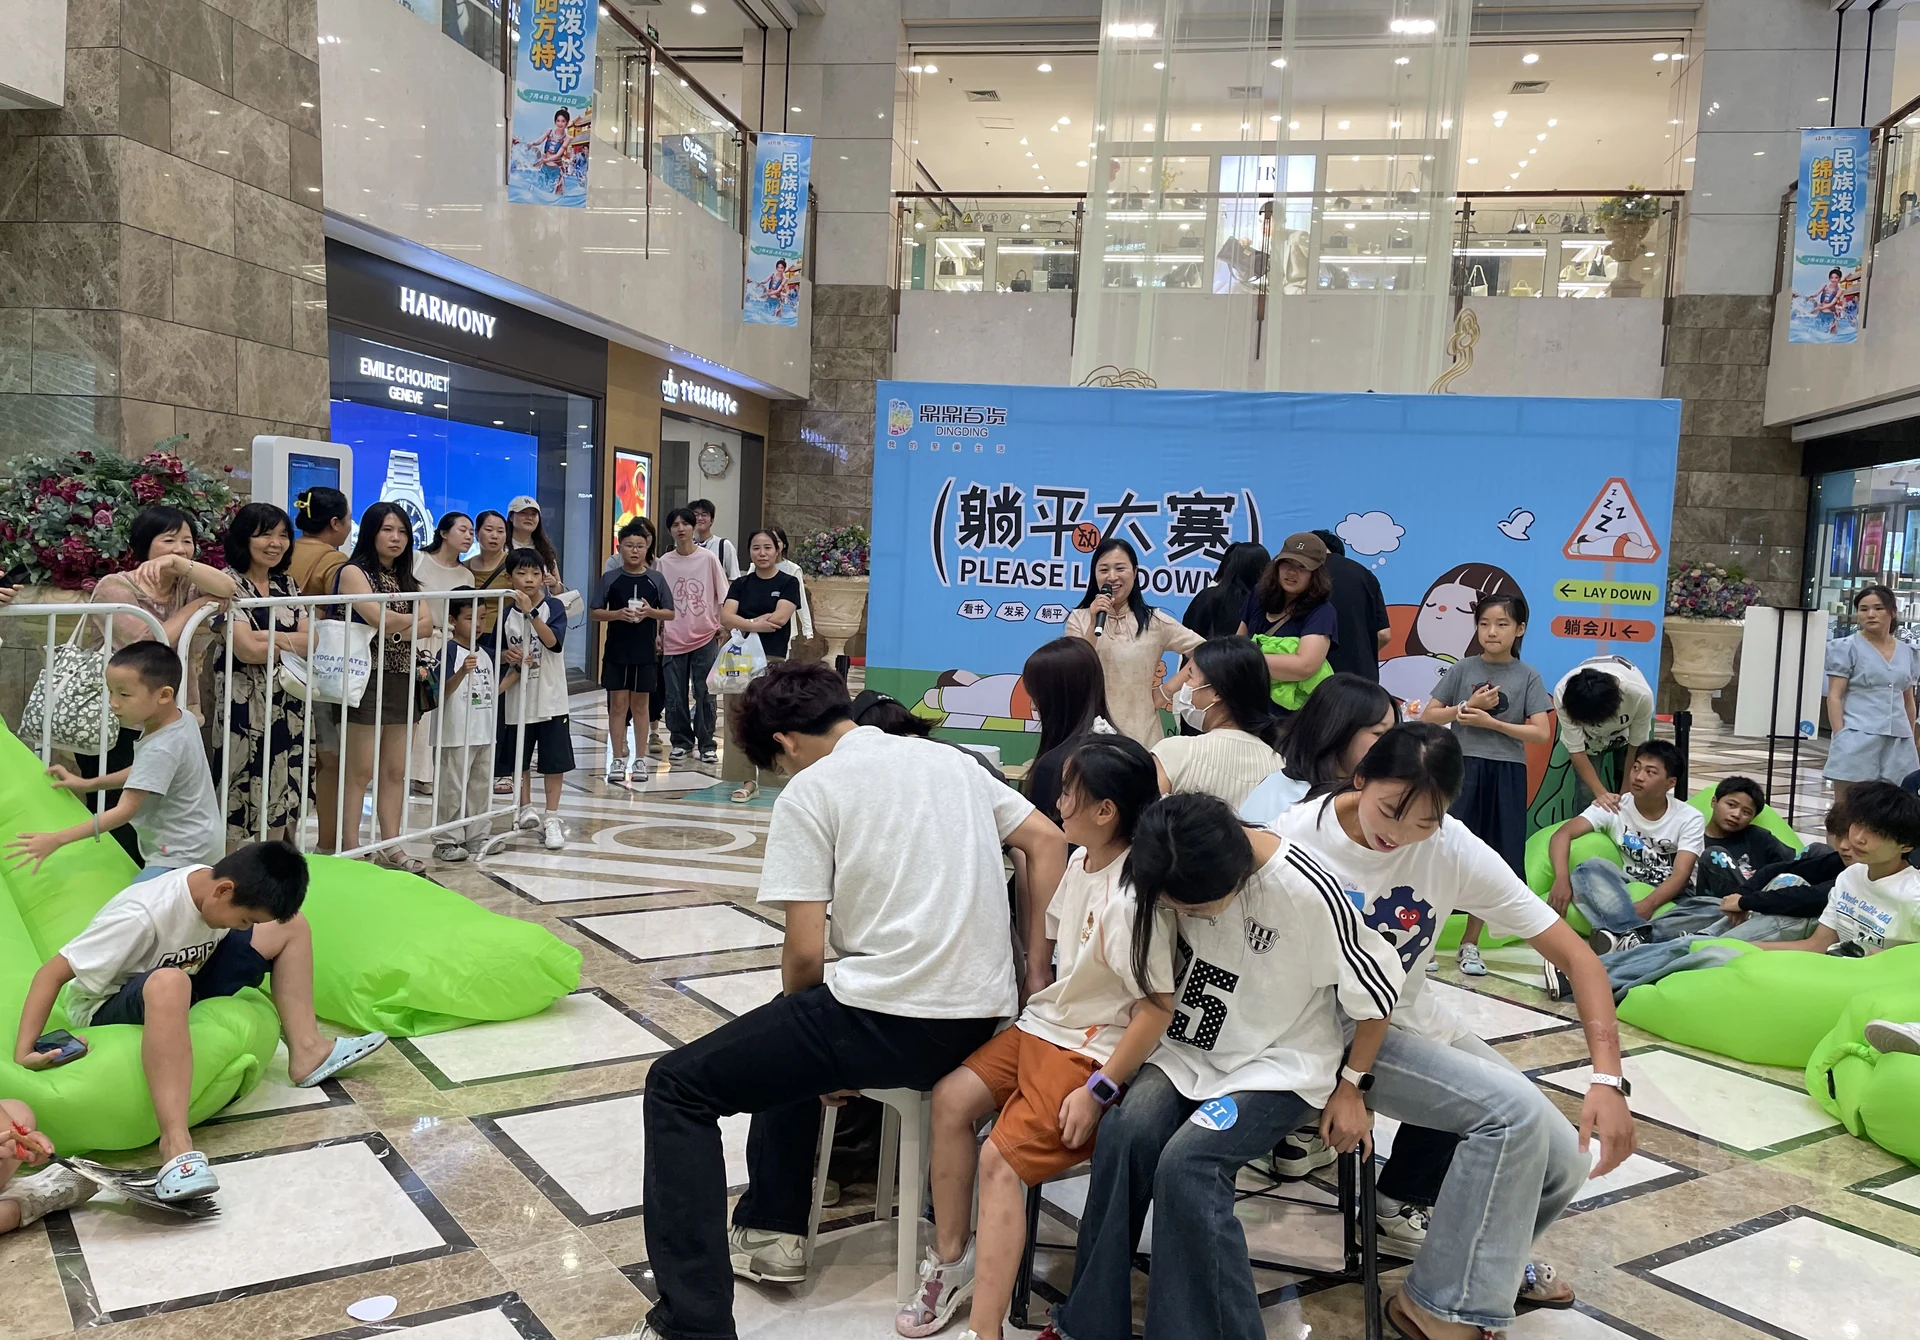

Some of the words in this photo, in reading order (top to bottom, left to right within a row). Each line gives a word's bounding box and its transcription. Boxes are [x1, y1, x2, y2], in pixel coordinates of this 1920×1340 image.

[555, 0, 584, 91] 泼水节
[761, 160, 782, 233] 绵阳方特
[777, 153, 798, 248] 民族泼水节
[1808, 158, 1833, 239] 绵阳方特
[1830, 148, 1855, 256] 民族泼水节
[400, 286, 497, 339] HARMONY
[360, 357, 396, 381] EMILE
[395, 366, 451, 393] CHOURIET
[388, 386, 424, 405] GENEVE
[919, 404, 1007, 425] 鼎鼎百货
[936, 426, 988, 437] DINGDING
[960, 561, 1064, 588] PLEASE
[1583, 587, 1607, 598] LAY
[1610, 588, 1651, 600] DOWN
[963, 604, 984, 614] 看书
[1003, 606, 1025, 617] 发呆
[1041, 608, 1063, 619] 躺平
[1564, 619, 1616, 638] 躺会儿
[332, 666, 366, 676] PILTES
[336, 656, 368, 667] PIATES
[1203, 1101, 1228, 1118] 15
